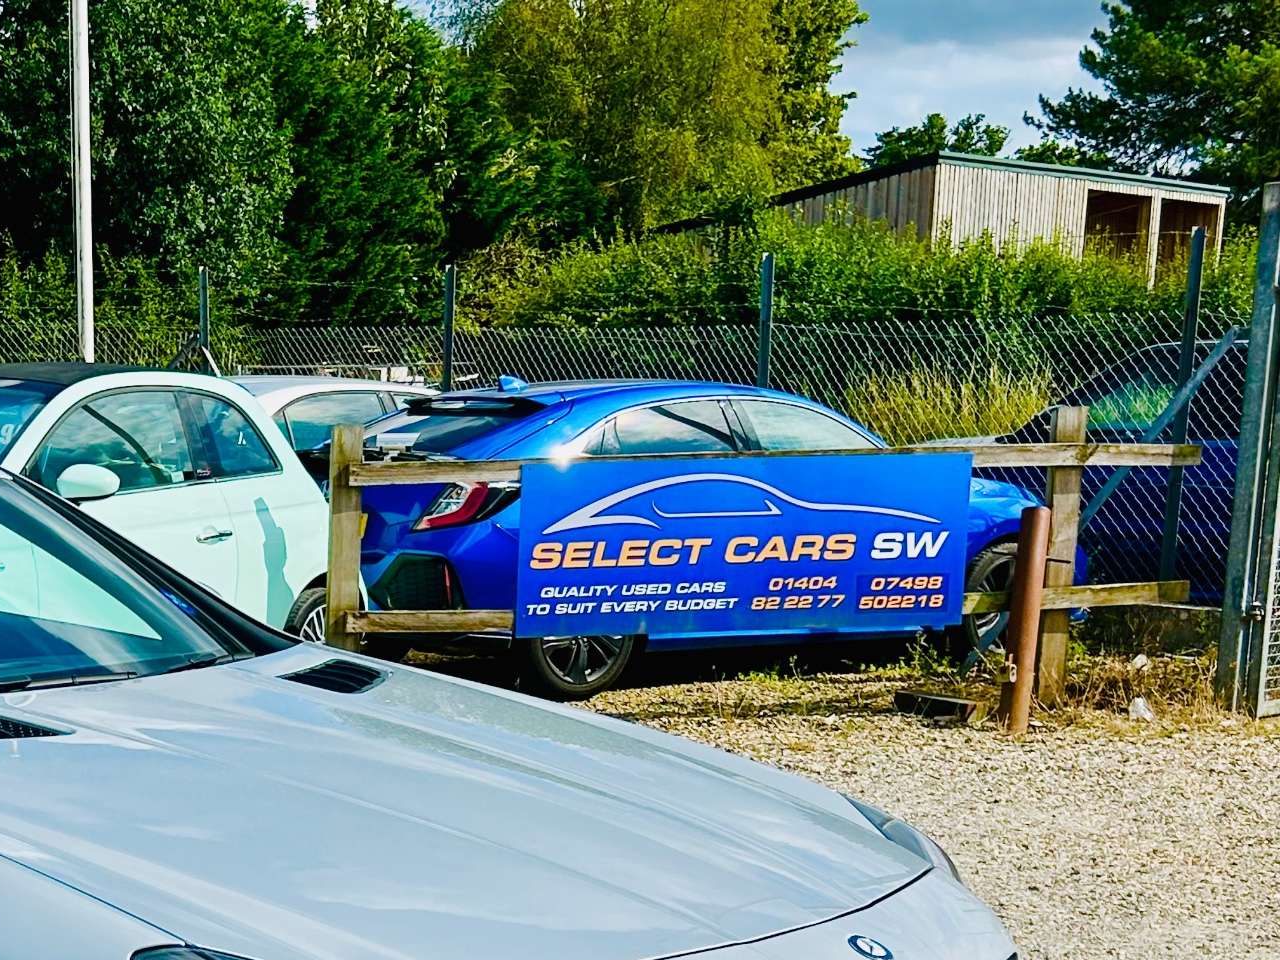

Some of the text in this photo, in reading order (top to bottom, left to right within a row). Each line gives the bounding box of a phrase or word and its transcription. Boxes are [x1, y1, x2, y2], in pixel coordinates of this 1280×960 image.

[530, 531, 949, 569] SELECT CARS SW
[540, 582, 726, 598] QUALITY USED CARS
[769, 576, 837, 591] 01404
[871, 576, 943, 590] 07498
[526, 598, 739, 615] TO SUIT EVERY BUDGET
[751, 594, 845, 610] 82 22 77
[858, 594, 944, 609] 502218
